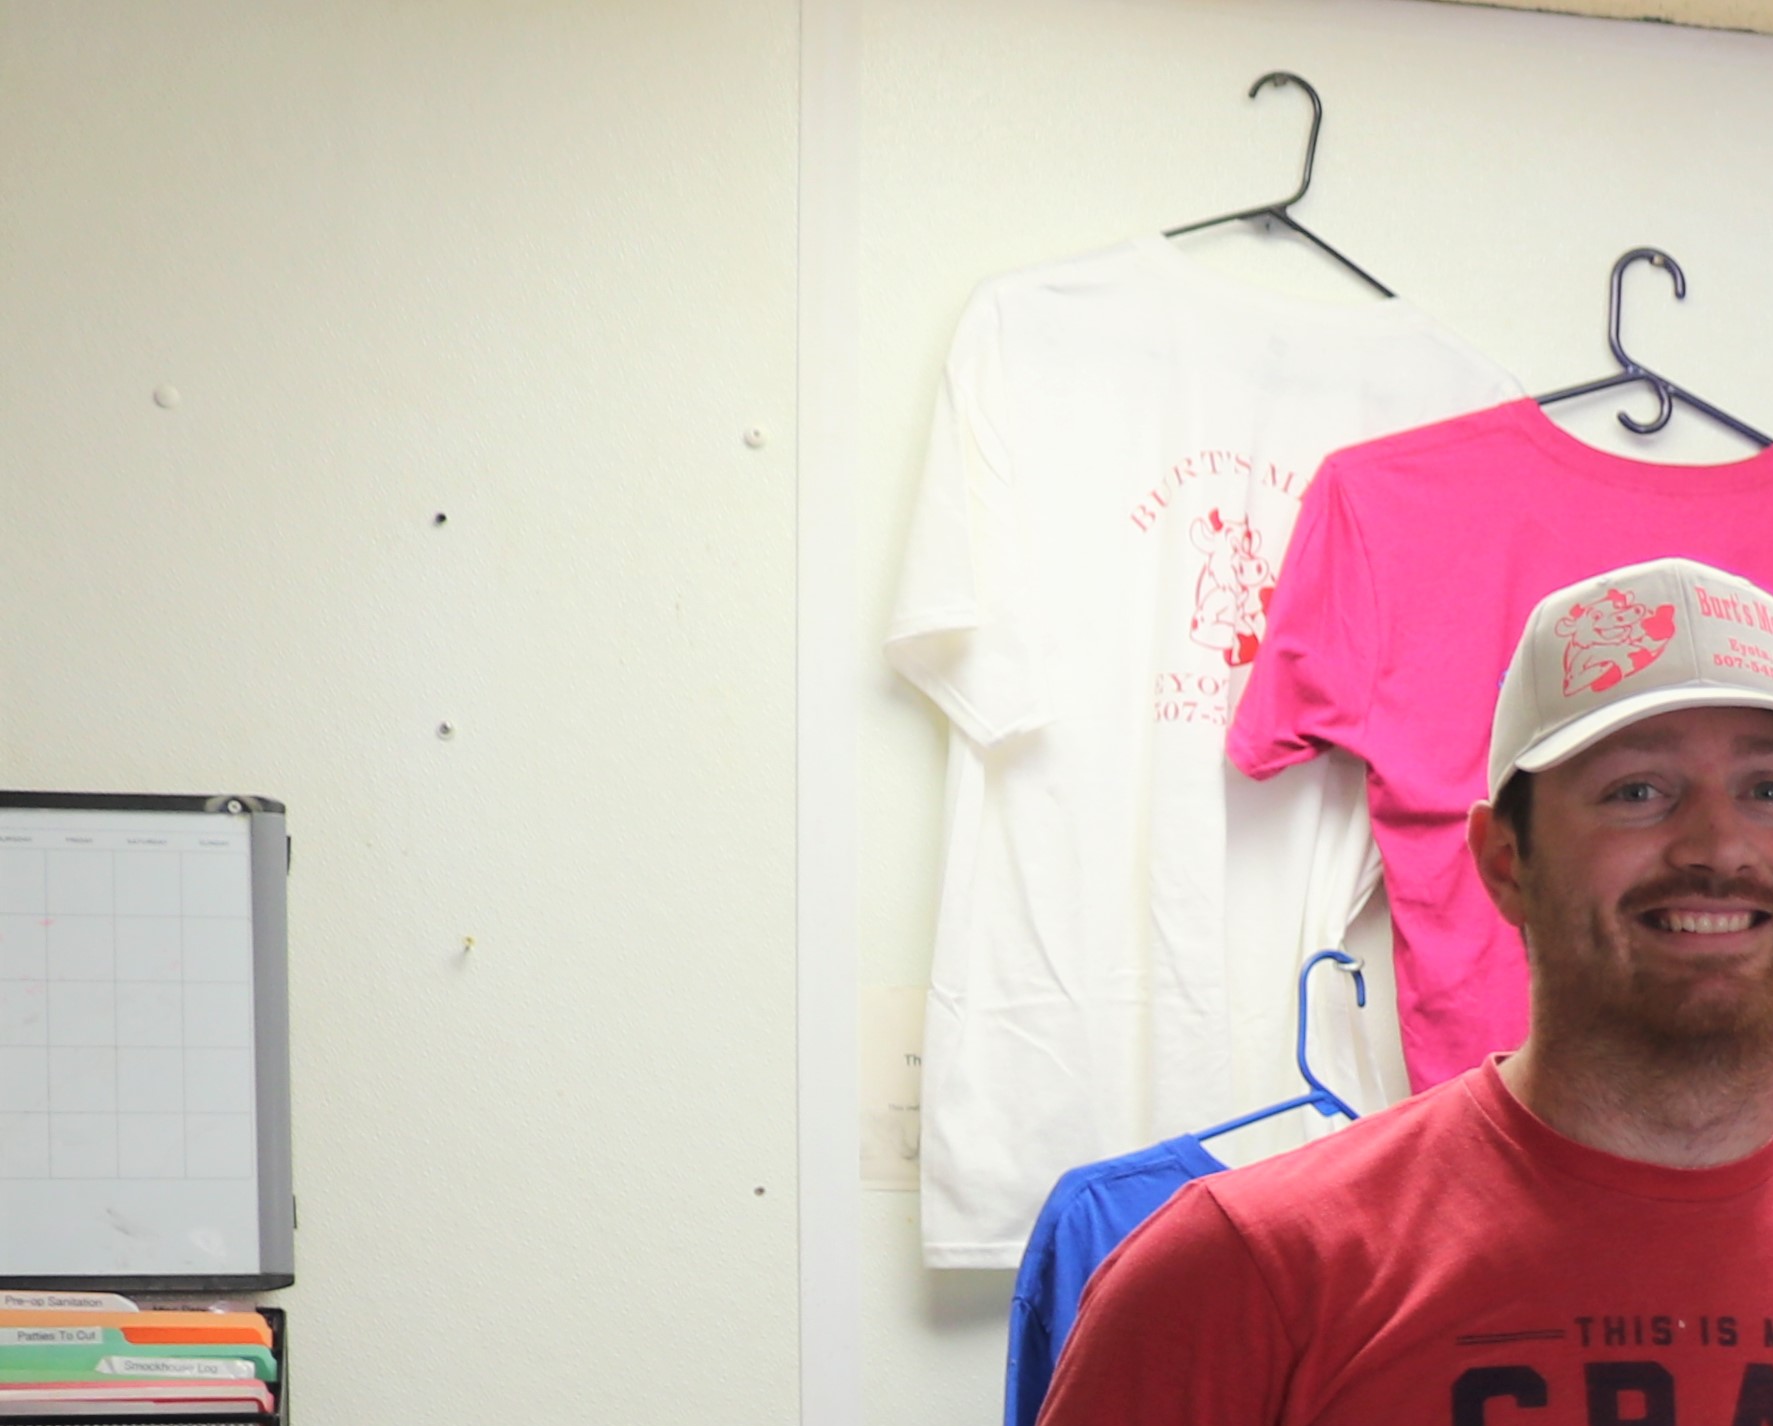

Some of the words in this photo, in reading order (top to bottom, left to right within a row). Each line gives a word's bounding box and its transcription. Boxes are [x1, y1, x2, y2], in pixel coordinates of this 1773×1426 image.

[1694, 585, 1755, 627] Burt's
[5, 1295, 44, 1308] Pre-op
[48, 1295, 104, 1309] Sanitation
[17, 1330, 56, 1342] Patties
[59, 1330, 74, 1341] To
[1573, 1315, 1674, 1349] THIS
[1701, 1316, 1739, 1346] IS
[197, 1363, 219, 1376] Log
